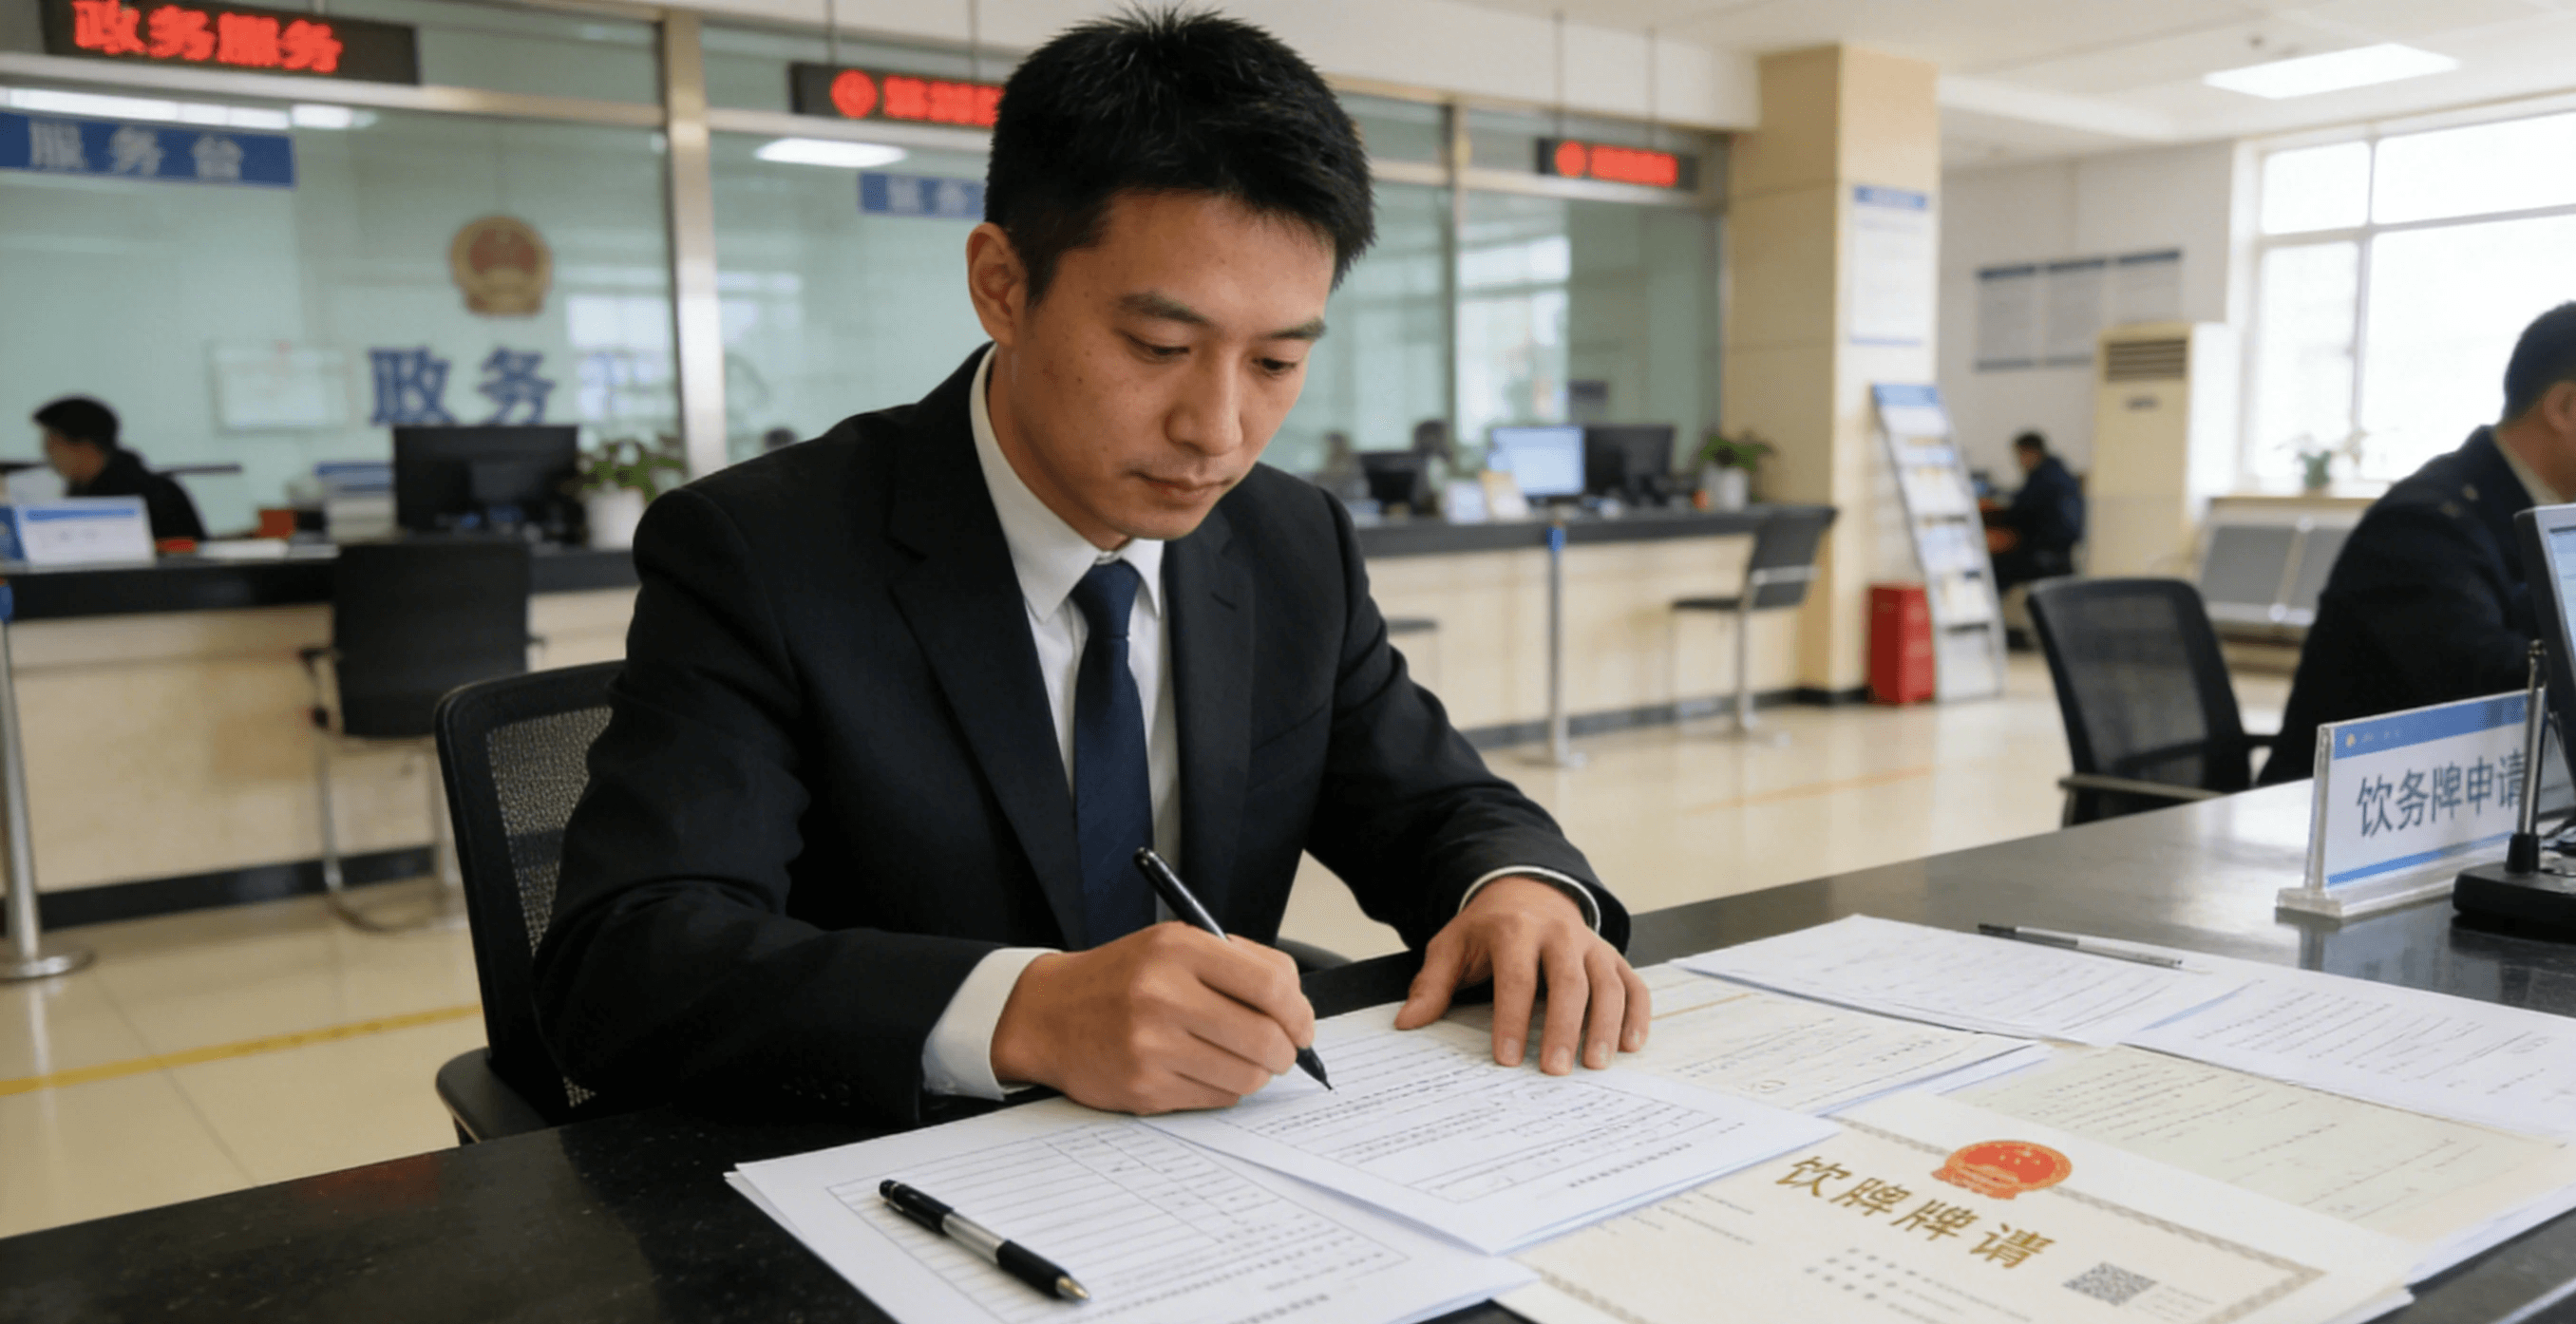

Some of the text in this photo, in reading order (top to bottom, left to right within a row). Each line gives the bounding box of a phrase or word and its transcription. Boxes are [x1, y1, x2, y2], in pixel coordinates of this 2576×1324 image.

[73, 0, 343, 73] 政务服务
[29, 123, 243, 178] 服务台
[369, 346, 556, 426] 政务
[2357, 747, 2525, 837] 饮务牌申请
